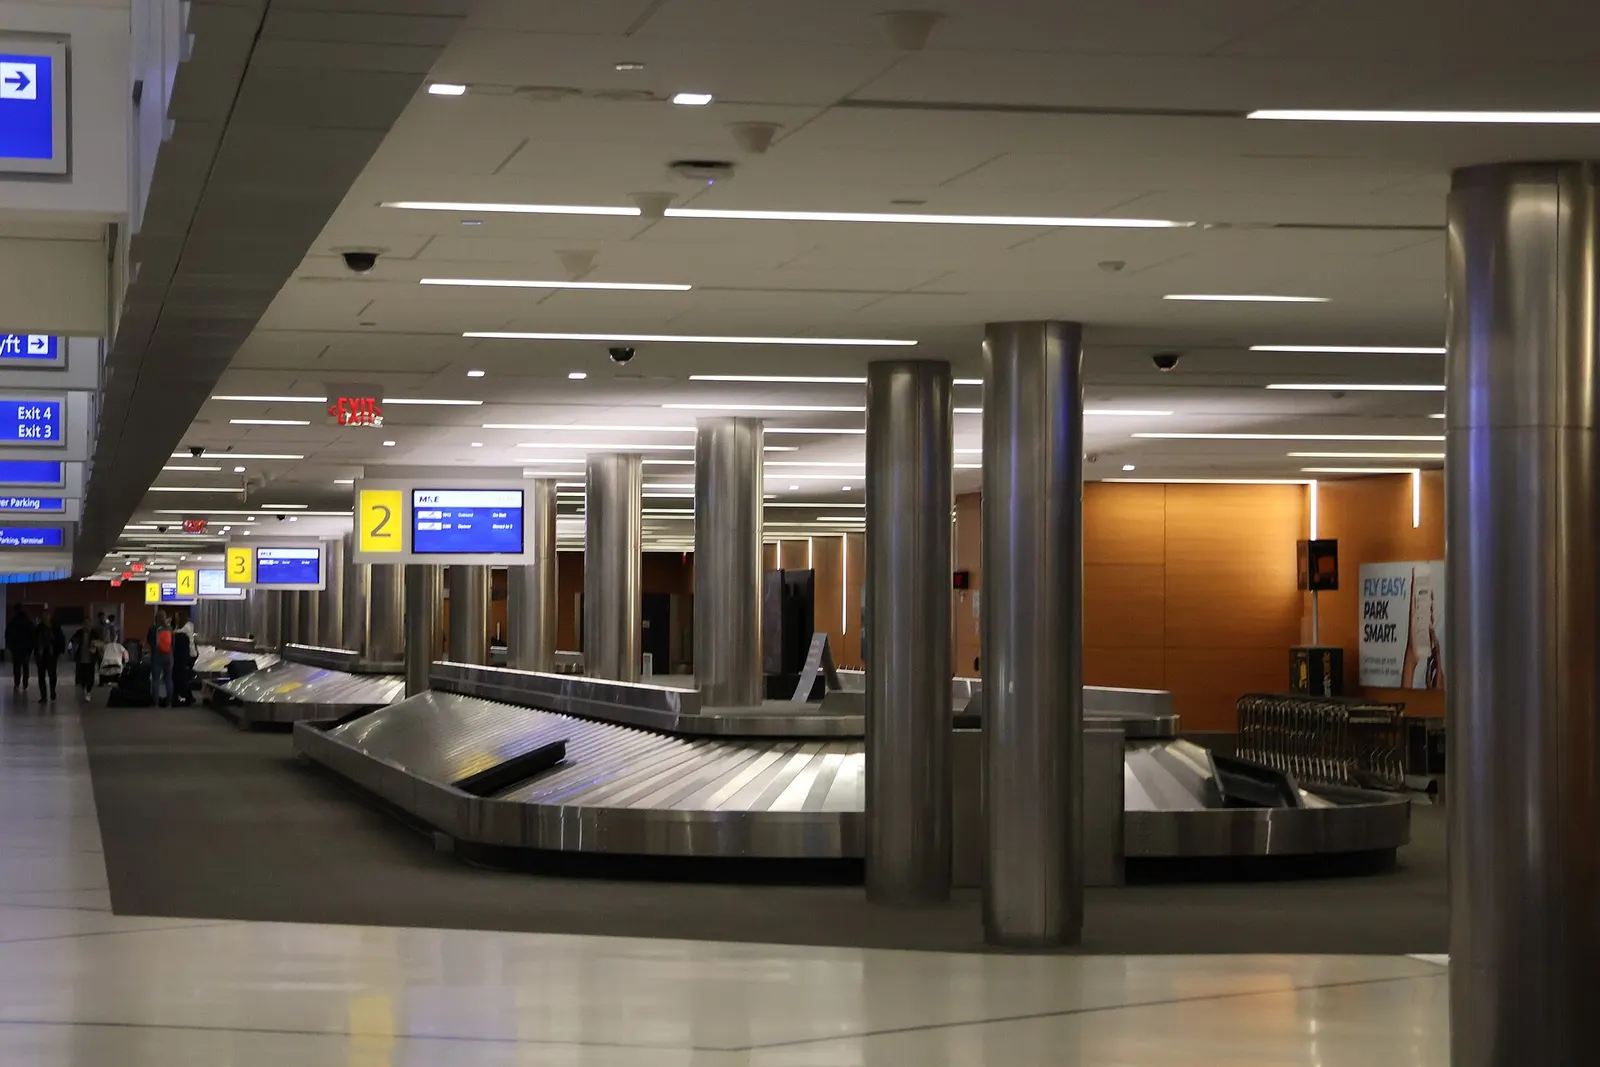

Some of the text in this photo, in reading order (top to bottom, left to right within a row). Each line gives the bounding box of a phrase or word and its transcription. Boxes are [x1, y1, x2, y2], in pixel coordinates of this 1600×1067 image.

[18, 406, 52, 420] Exit 4
[337, 397, 376, 425] EXIT
[18, 424, 52, 438] Exit 3
[10, 498, 40, 509] Parking
[371, 505, 392, 538] 2
[21, 537, 44, 545] Terminal
[234, 556, 246, 574] 3
[181, 576, 190, 588] 4
[1363, 577, 1407, 599] FLY EASY,
[149, 587, 156, 596] 5
[1363, 600, 1389, 620] PARK
[1363, 623, 1397, 643] SMART.
